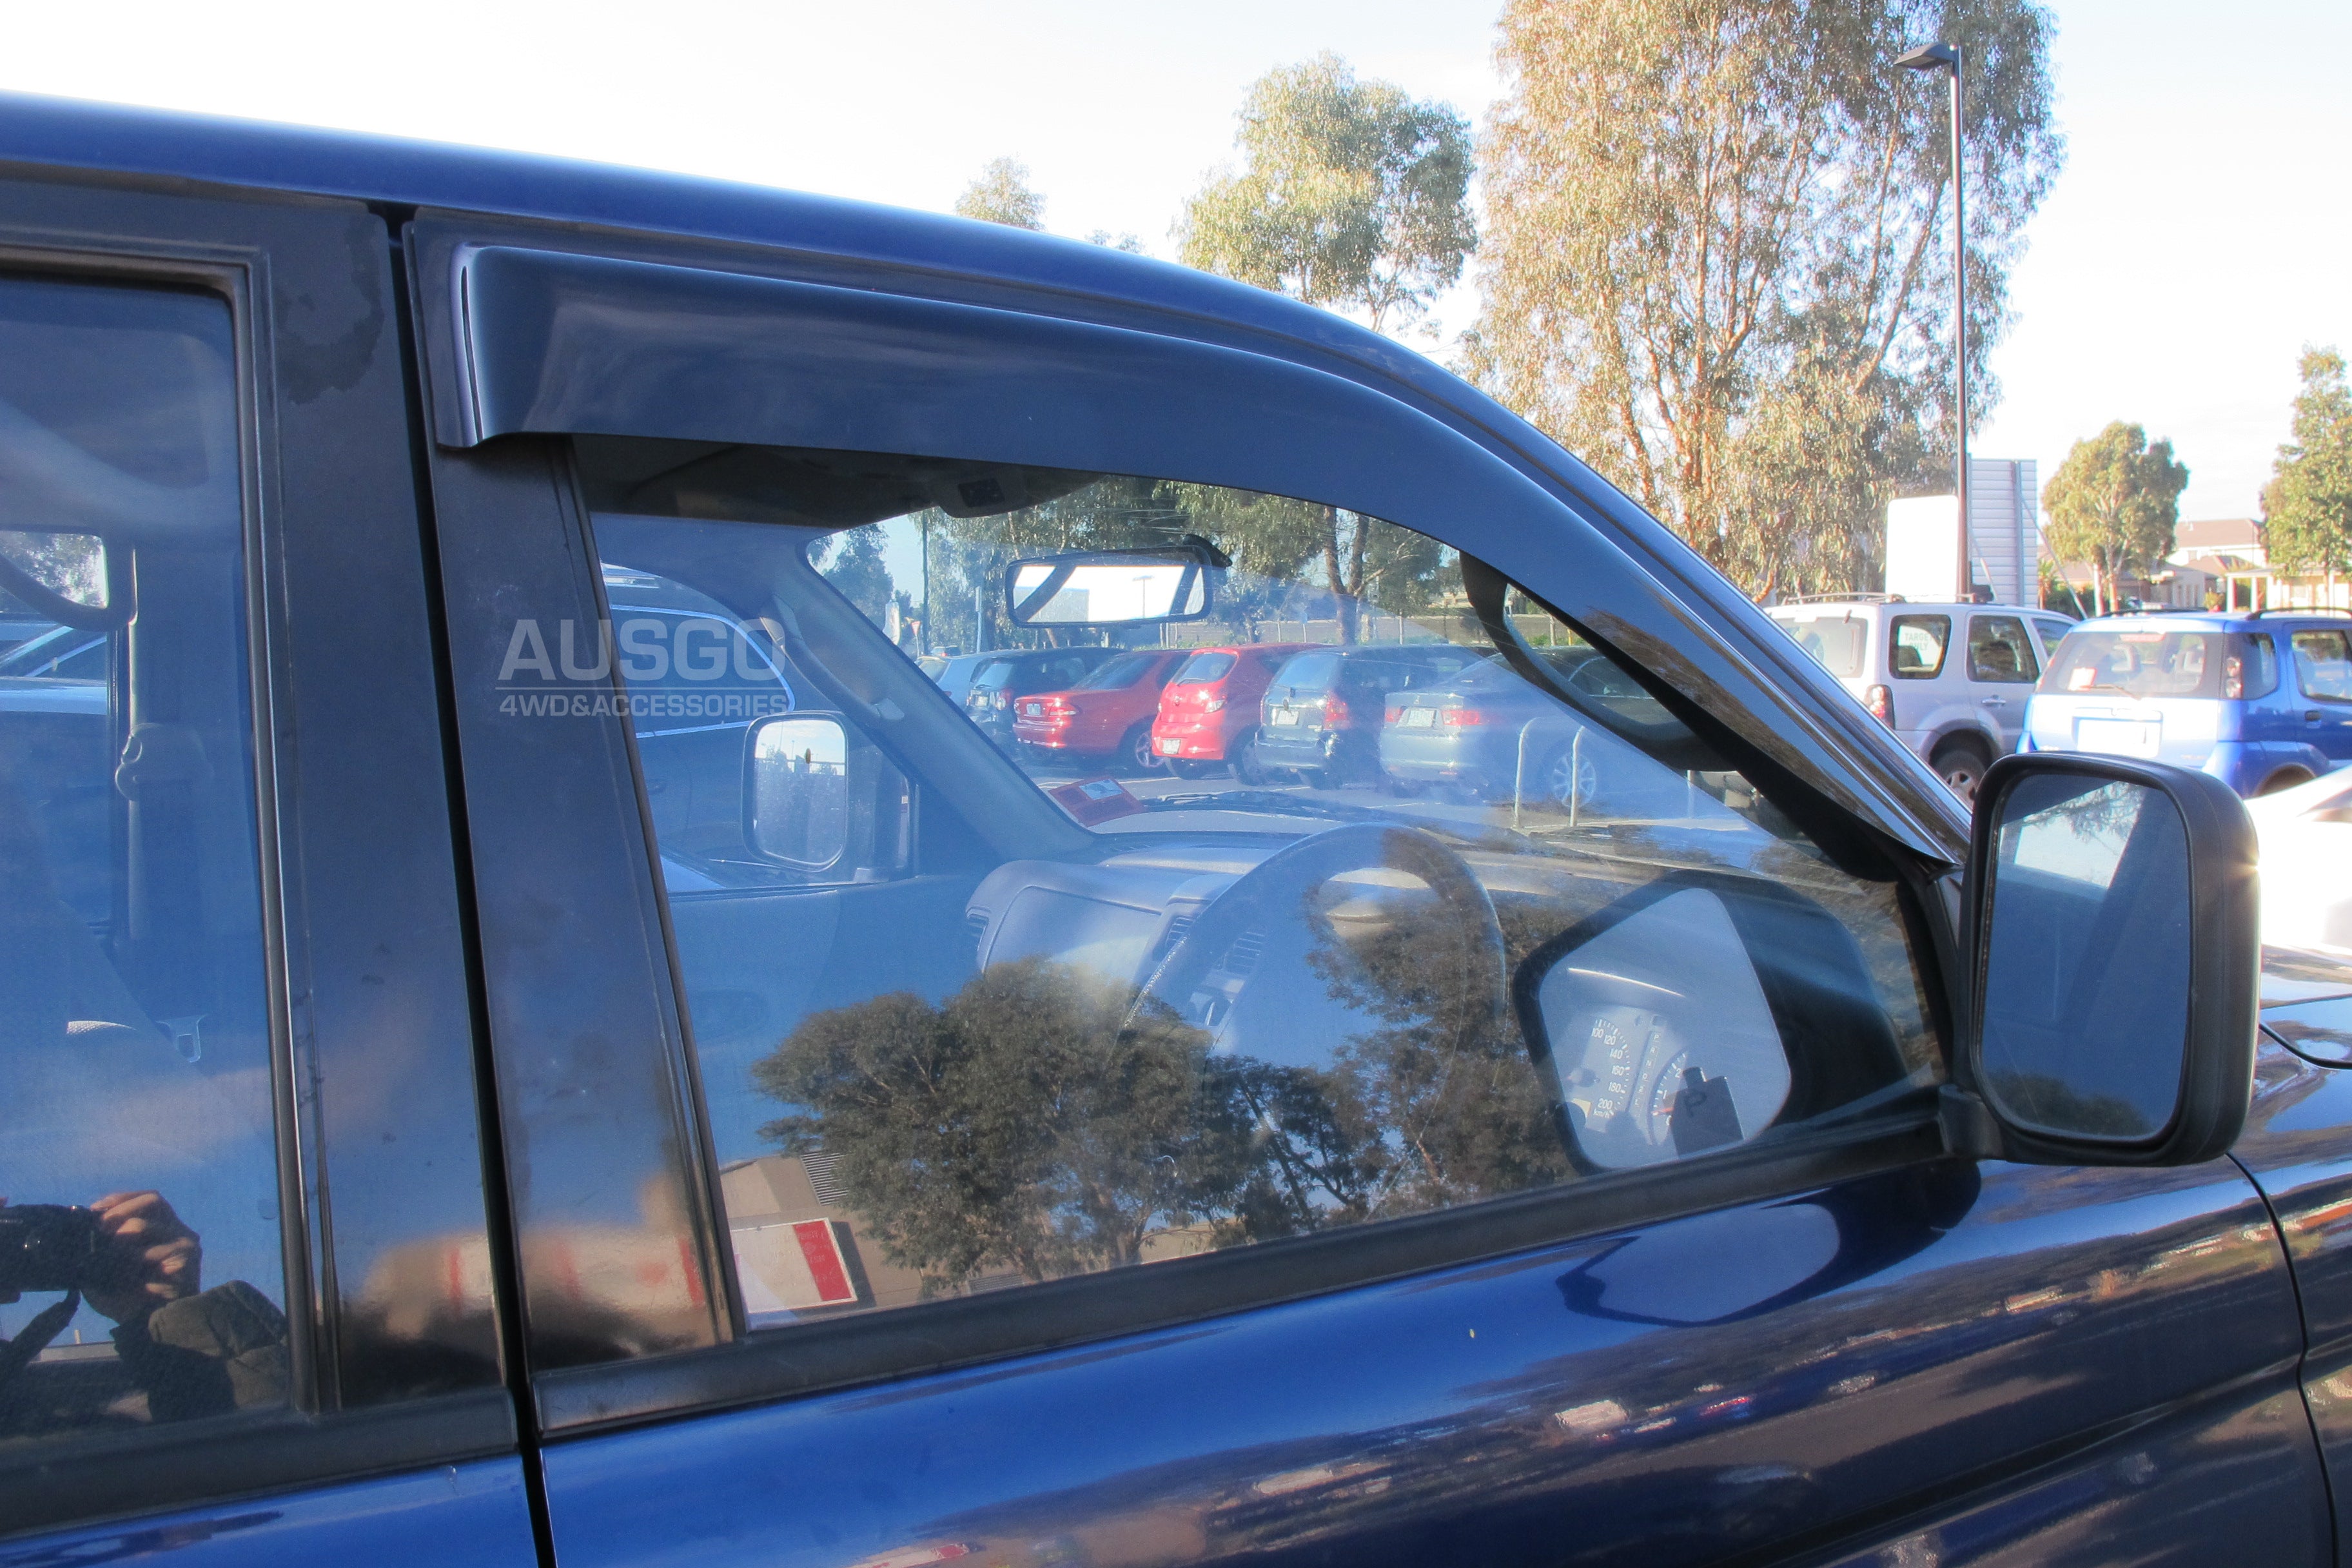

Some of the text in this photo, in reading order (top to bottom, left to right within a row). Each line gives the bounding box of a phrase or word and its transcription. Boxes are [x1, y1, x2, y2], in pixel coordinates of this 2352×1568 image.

[1905, 632, 1932, 641] TARGE
[1591, 1028, 1604, 1039] 100
[1604, 1035, 1616, 1045] 120
[1609, 1048, 1623, 1059] 140
[1674, 1068, 1682, 1079] 2
[1598, 1097, 1612, 1110] 200
[1593, 1108, 1610, 1119] km/h
